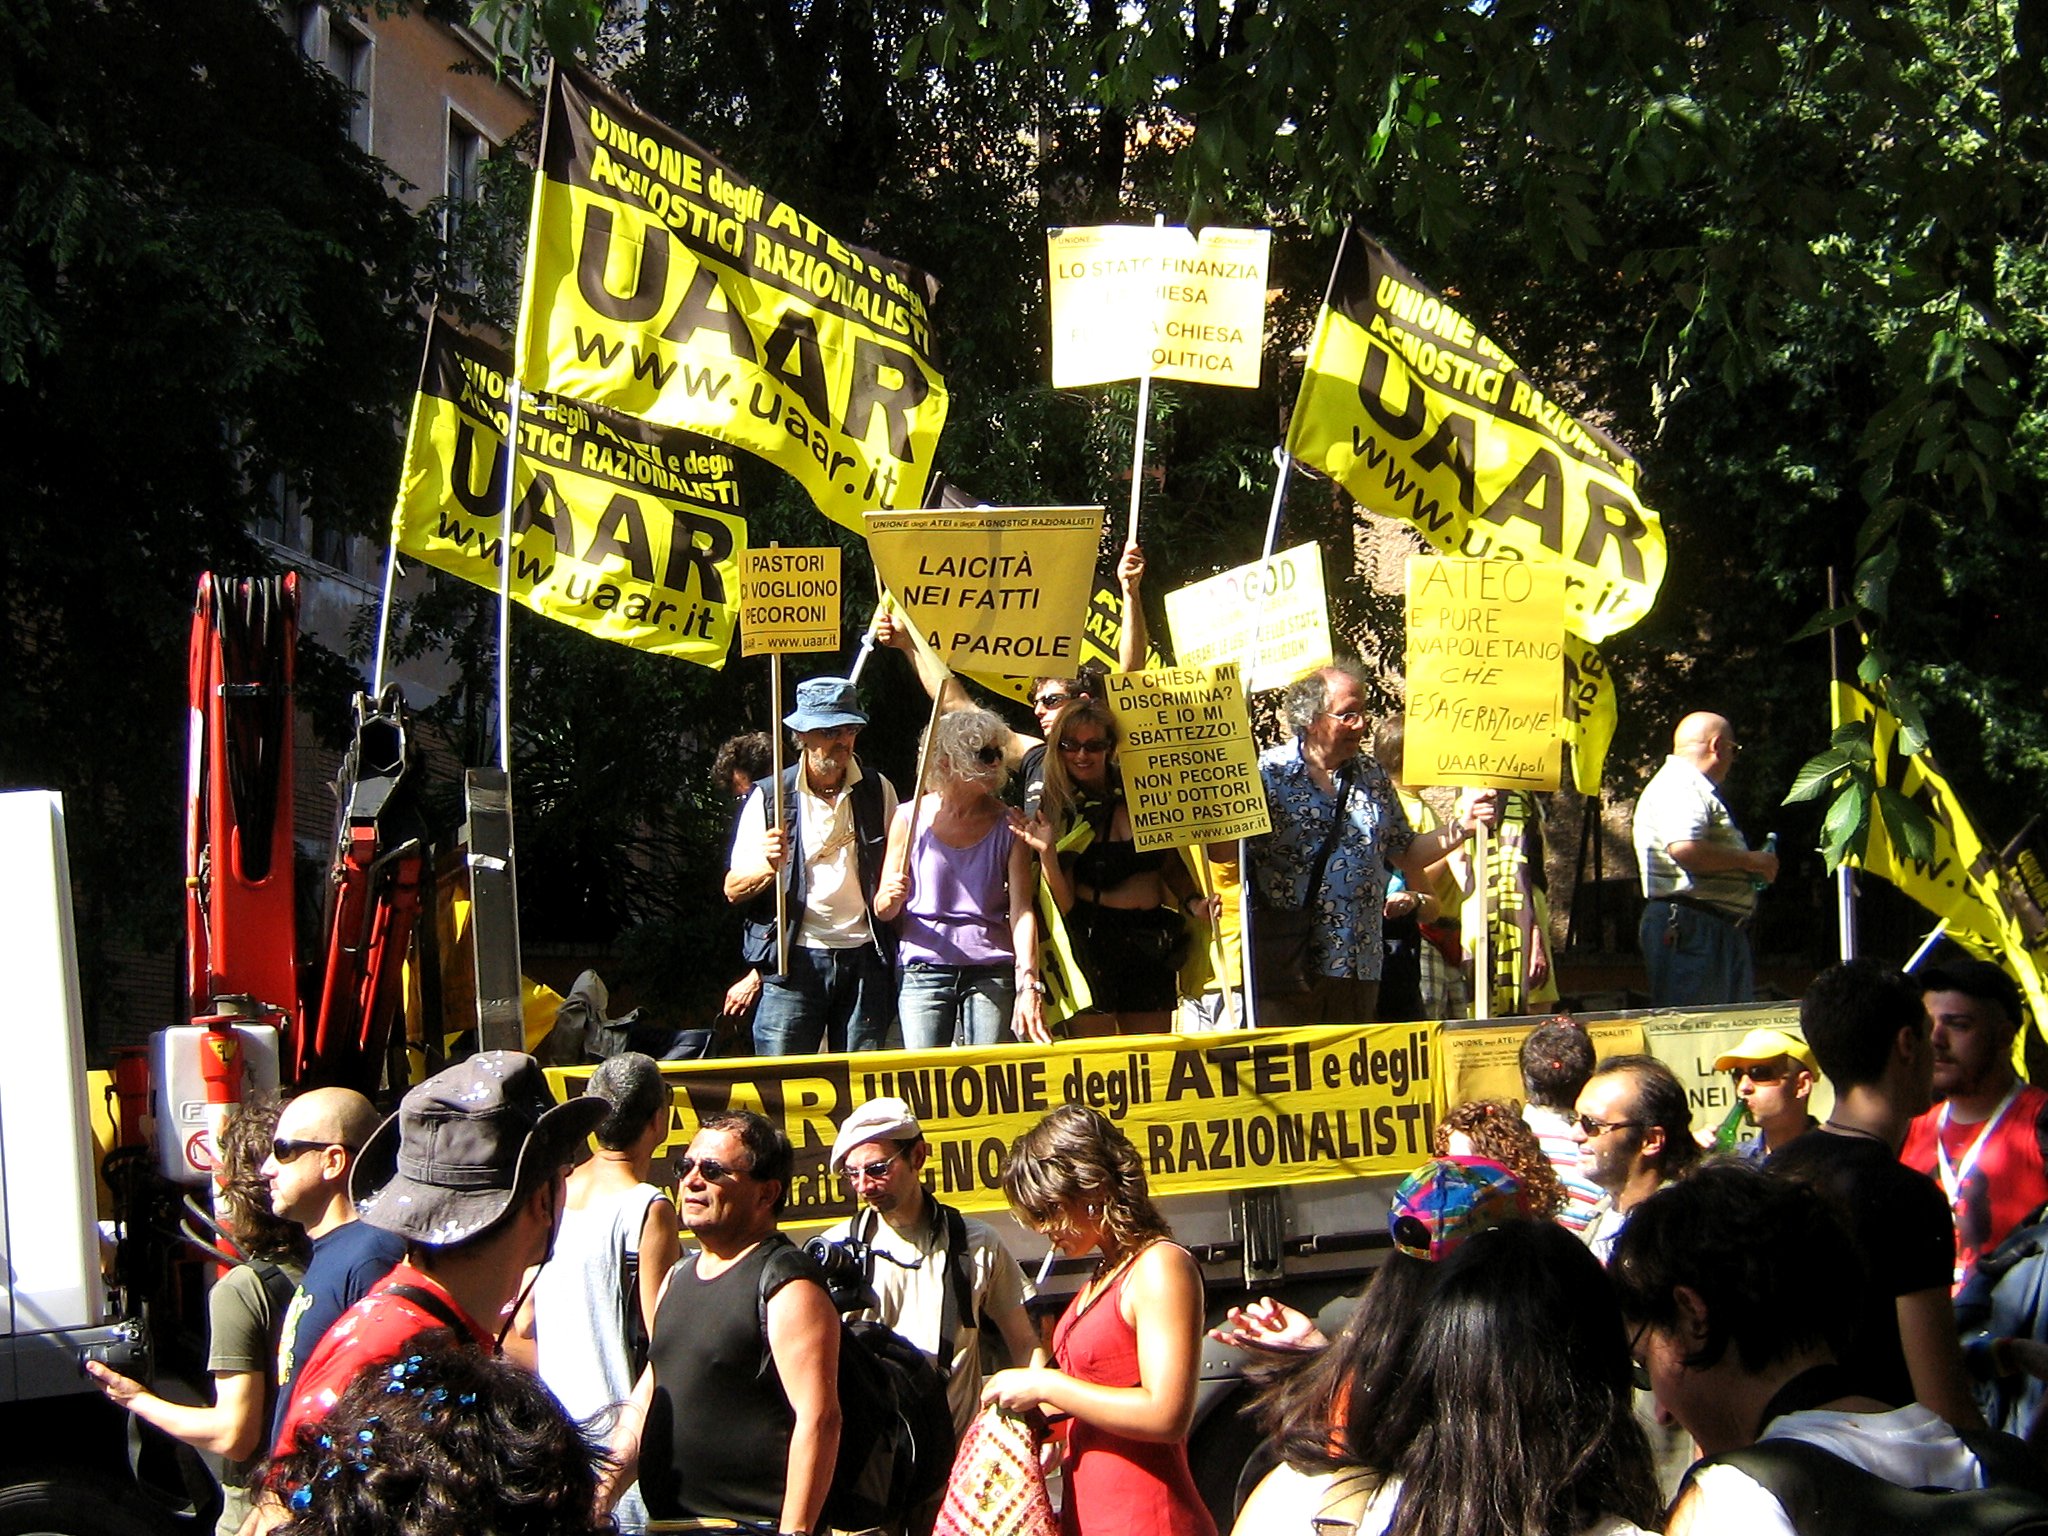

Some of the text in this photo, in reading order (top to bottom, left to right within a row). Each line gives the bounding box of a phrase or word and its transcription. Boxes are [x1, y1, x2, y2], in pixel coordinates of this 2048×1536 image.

[590, 105, 703, 195] UNIONE
[708, 167, 765, 224] degli
[1059, 262, 1086, 279] LO
[1161, 259, 1259, 280] FINANZIA
[754, 233, 930, 356] RAZIONALISTI
[1376, 275, 1477, 349] UNIONE
[576, 203, 931, 464] UAAR
[1166, 321, 1243, 344] CHIESA
[1150, 349, 1234, 371] OLITICA
[574, 325, 899, 510] www.uaar.it
[581, 441, 740, 507] RAZIONALISTI
[668, 455, 680, 473] e
[1358, 341, 1648, 584] UAAR
[451, 416, 734, 605] UAAR
[872, 521, 909, 529] UNIONE
[929, 519, 952, 527] ATEI
[977, 518, 1030, 528] AGNOSTICI
[1030, 518, 1095, 526] RAZIONALISTI
[438, 511, 716, 640] www.uaar.it
[752, 555, 824, 573] PASTORI
[919, 551, 1033, 578] LAICITÀ
[751, 580, 838, 598] VOGLIONO
[1244, 559, 1296, 602] GOD
[1421, 560, 1533, 603] ATEO
[904, 586, 1040, 610] NEI FATTI
[746, 605, 826, 625] PECORONI
[1411, 607, 1502, 634] E PURE
[767, 634, 837, 648] www.uaar.it
[927, 631, 1072, 658] A PAROLE
[1409, 637, 1562, 661] NAPOLETANO
[1110, 666, 1236, 692] LA CHIESA MI
[1440, 666, 1503, 686] CHE
[1120, 686, 1233, 711] DISCRIMINA?
[1177, 709, 1195, 723] IO
[1203, 705, 1223, 721] MI
[1129, 721, 1238, 746] SBATTEZZO!
[1148, 747, 1227, 770] PERSONE
[1134, 762, 1249, 791] NON PECORE
[1177, 780, 1251, 803] DOTTORI
[1134, 797, 1264, 828] MENO PASTORI
[1138, 831, 1174, 846] UAAR
[1191, 819, 1268, 839] www.uaar.it
[1453, 1039, 1483, 1048] UNIONE
[1497, 1037, 1516, 1045] ATEI
[1063, 1053, 1152, 1120] degli
[1166, 1042, 1313, 1101] ATEI
[1323, 1053, 1342, 1088] e
[1350, 1030, 1430, 1097] degli
[1689, 1086, 1728, 1109] NEI
[1147, 1102, 1434, 1176] RAZIONALISTI
